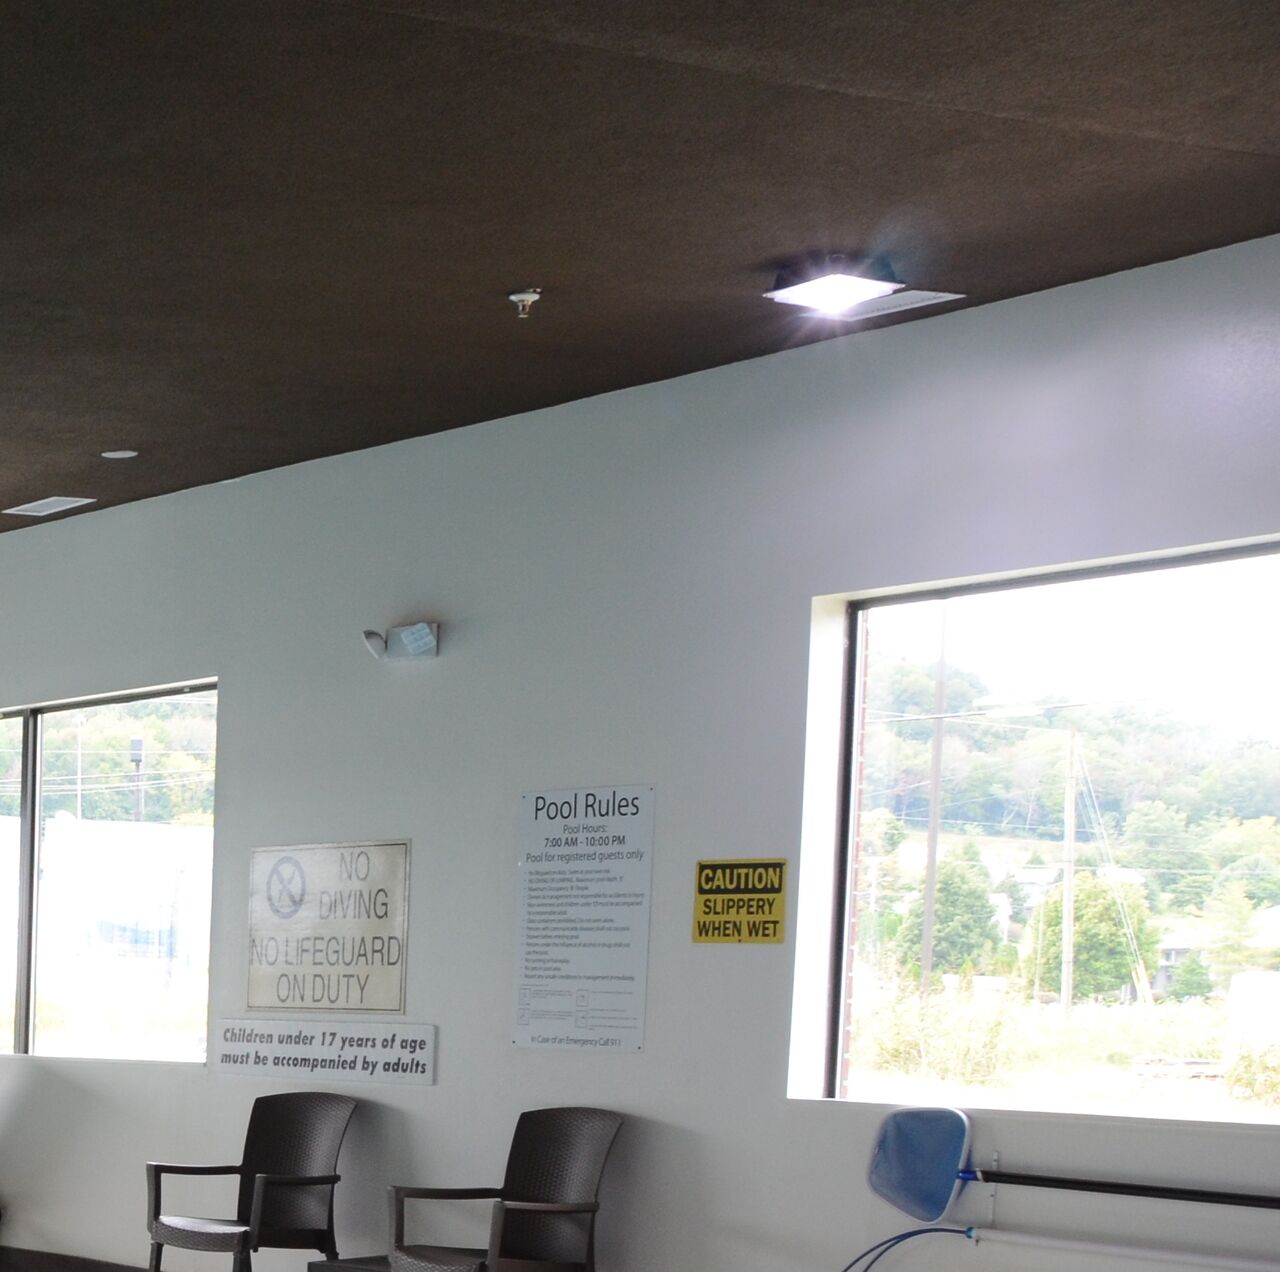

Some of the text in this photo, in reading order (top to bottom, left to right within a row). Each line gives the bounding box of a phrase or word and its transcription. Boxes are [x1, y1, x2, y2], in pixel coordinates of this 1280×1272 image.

[534, 790, 640, 821] Pool Rules
[544, 837, 562, 848] 7:00
[563, 837, 578, 847] AM
[585, 836, 610, 847] 10:00
[611, 835, 626, 846] PM
[563, 824, 580, 834] Pool
[340, 851, 370, 881] NO
[526, 849, 645, 864] Pool for registered guests only
[700, 867, 780, 890] CAUTION
[319, 888, 389, 920] DIVING
[702, 898, 776, 916] SLIPPERY
[697, 920, 780, 937] WHEN WET
[251, 936, 401, 966] NO LIFEGUARD
[276, 973, 370, 1004] ON DUTY
[223, 1027, 427, 1054] Children under 17 years of age
[220, 1051, 427, 1076] must be accompanied by adults
